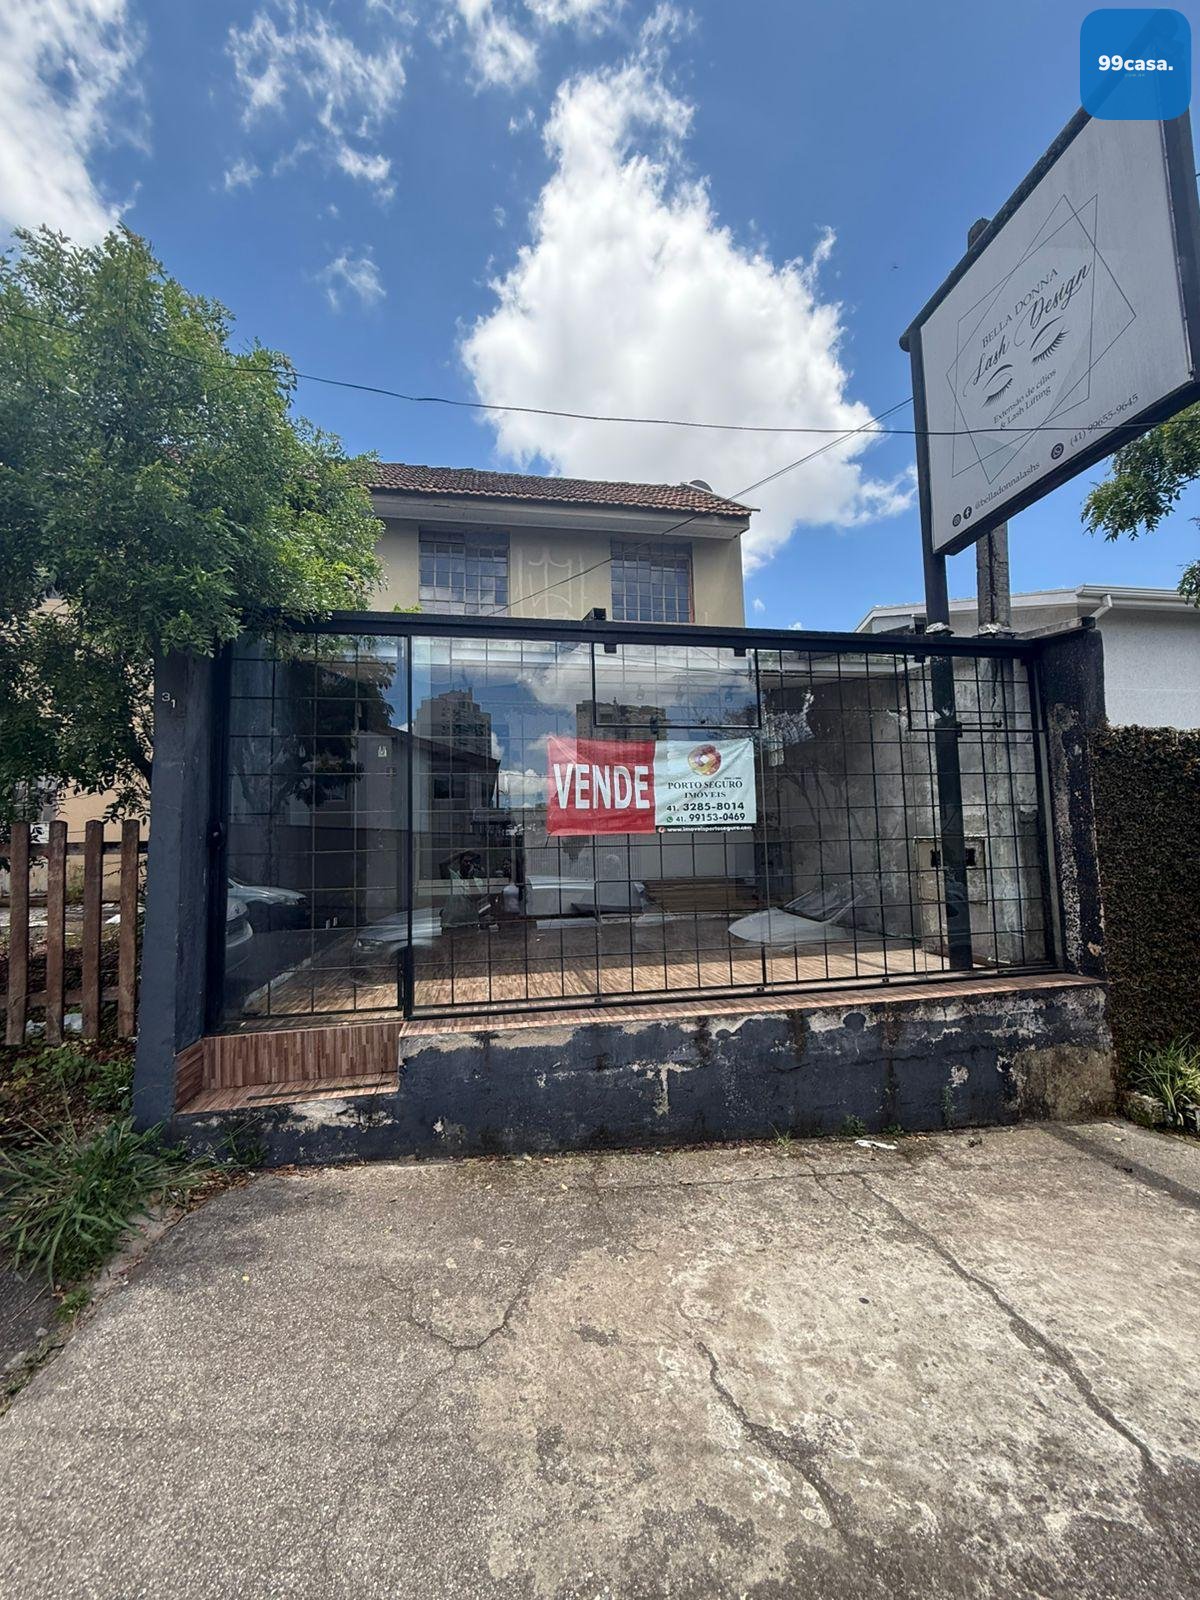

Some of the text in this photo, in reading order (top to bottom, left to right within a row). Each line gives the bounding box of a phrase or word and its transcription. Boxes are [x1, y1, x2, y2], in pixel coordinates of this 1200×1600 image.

[982, 268, 1059, 348] BELLA DONNA
[963, 262, 1092, 397] Lash Design
[1025, 386, 1036, 398] de
[1007, 406, 1025, 424] Lash
[1025, 386, 1052, 410] Lifting
[1070, 429, 1086, 447] (41)
[161, 692, 176, 708] 31
[553, 763, 650, 810] VENDE
[667, 780, 743, 790] PORTO SEGURO
[684, 790, 726, 799] IMÓVEIS
[683, 802, 745, 811] 3285-8014
[689, 812, 746, 822] 99153-0469
